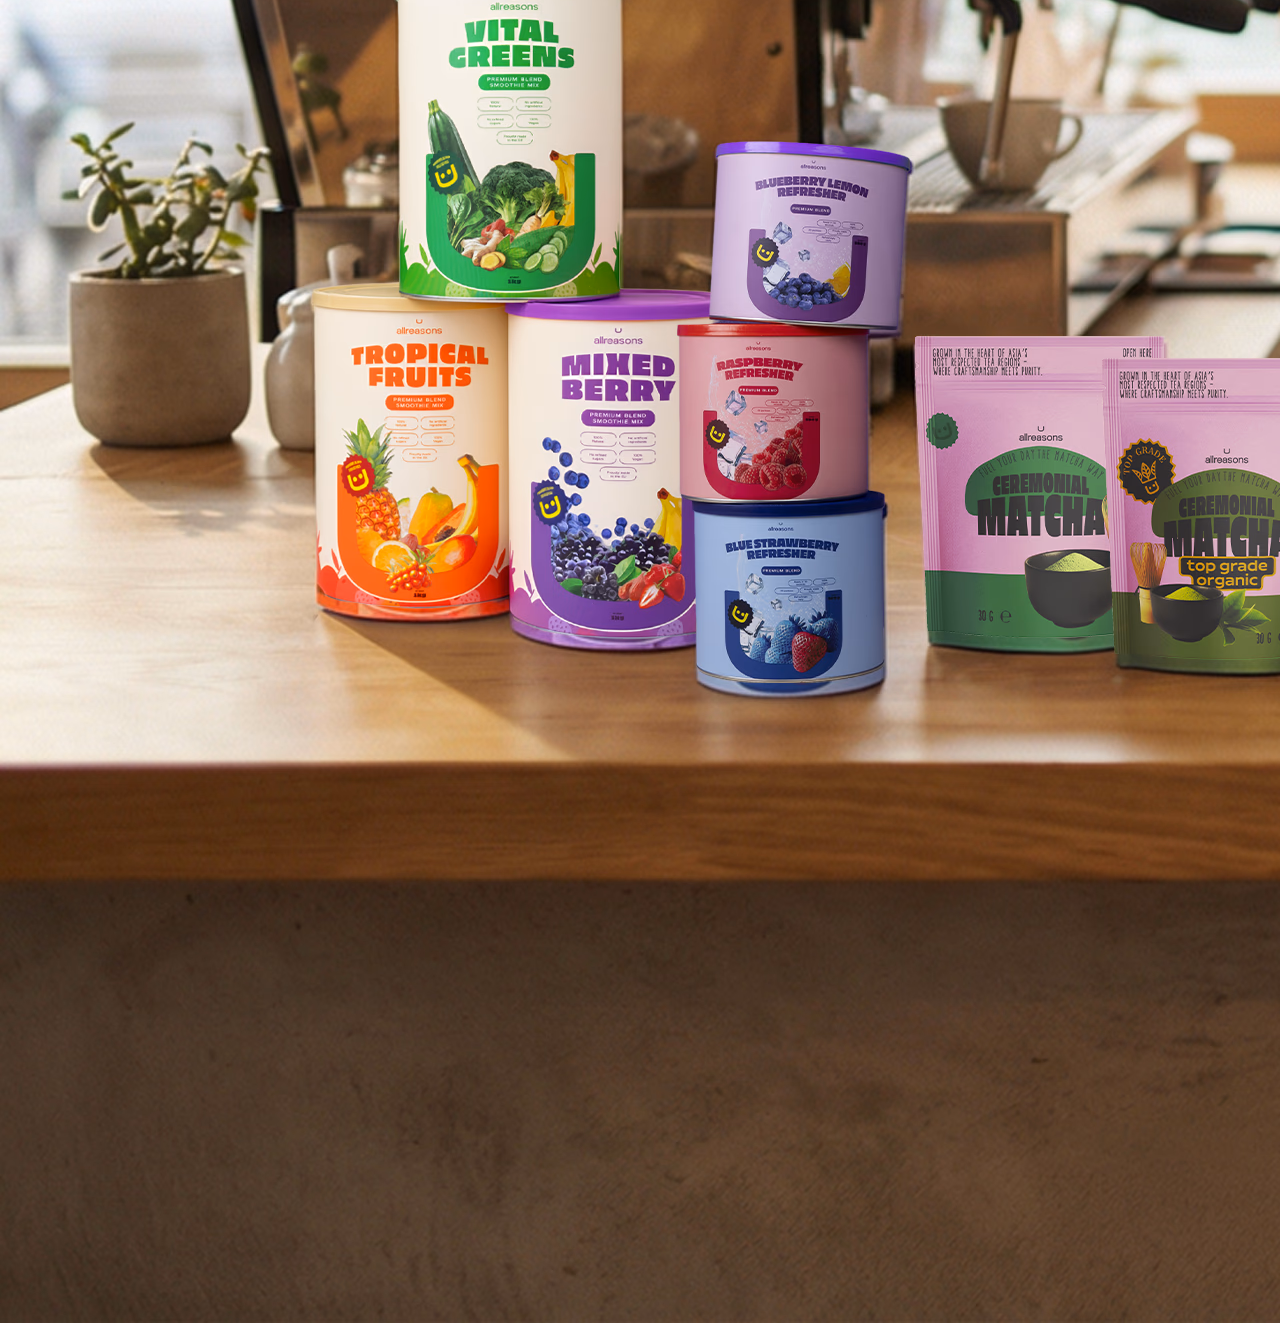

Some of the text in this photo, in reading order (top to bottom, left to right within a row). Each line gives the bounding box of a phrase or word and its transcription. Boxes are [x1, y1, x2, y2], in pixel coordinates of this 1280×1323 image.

[490, 2, 539, 11] allreasons
[464, 19, 559, 44] VITAL
[449, 44, 575, 69] GREENS
[755, 176, 869, 198] BLUEBERRY LEMON
[777, 186, 847, 202] REFRESHER
[594, 336, 643, 344] allreasons
[351, 343, 489, 366] TROPICAL
[932, 348, 1028, 358] GROWN IN THE HEART OF ASIA'S
[561, 353, 676, 377] MIXED
[716, 357, 804, 372] RASPBERRY
[932, 358, 1020, 366] MOST RESPECTED TEA REGIONS
[368, 366, 472, 388] FRUITS
[724, 368, 795, 382] REFRESHER
[932, 366, 1043, 376] WHERE CRAFTSMANSHIP MEETS PURITY.
[561, 378, 676, 402] BERRY
[1018, 433, 1063, 442] allreasons
[1124, 446, 1167, 476] TOP GRADE
[1205, 456, 1248, 464] allreasons
[992, 472, 1089, 496] CEREMONIAL
[1179, 494, 1275, 517] CEREMONIAL
[977, 494, 1105, 537] MATCHA
[725, 538, 840, 553] BLUE STRAWBERRY
[746, 548, 816, 560] REFRESHER
[1187, 560, 1268, 574] top grade
[1196, 574, 1259, 589] organic
[978, 610, 994, 622] 30 G
[1256, 632, 1272, 644] 30 G
